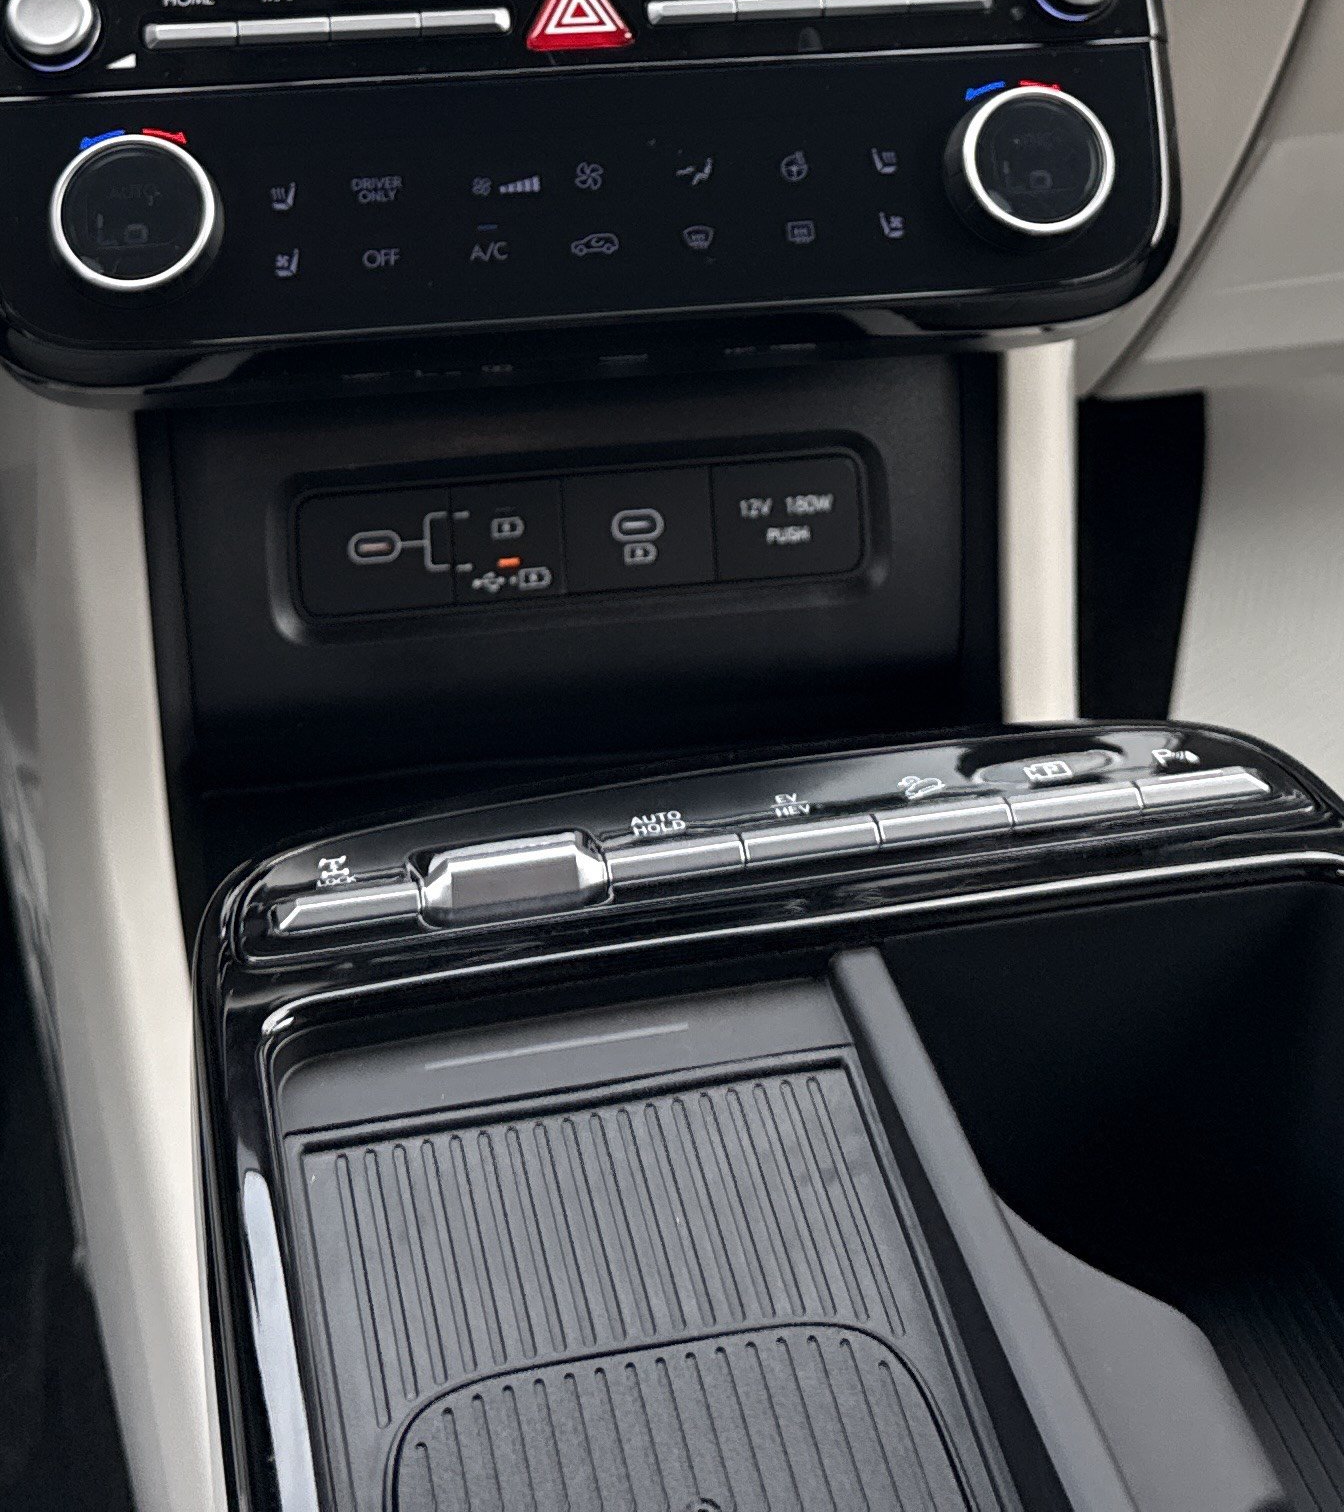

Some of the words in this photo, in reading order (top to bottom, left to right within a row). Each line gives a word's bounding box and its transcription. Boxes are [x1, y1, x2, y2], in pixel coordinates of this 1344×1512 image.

[351, 175, 403, 191] DRIVER
[358, 189, 397, 204] ONLY
[362, 247, 401, 268] OFF
[469, 240, 509, 262] A/C
[739, 497, 773, 518] 12V
[766, 525, 811, 545] PUSH
[774, 792, 797, 804] EV
[630, 809, 682, 827] AUTO
[775, 803, 810, 818] HEV
[632, 819, 686, 838] HOLD
[316, 873, 356, 887] LOCK
